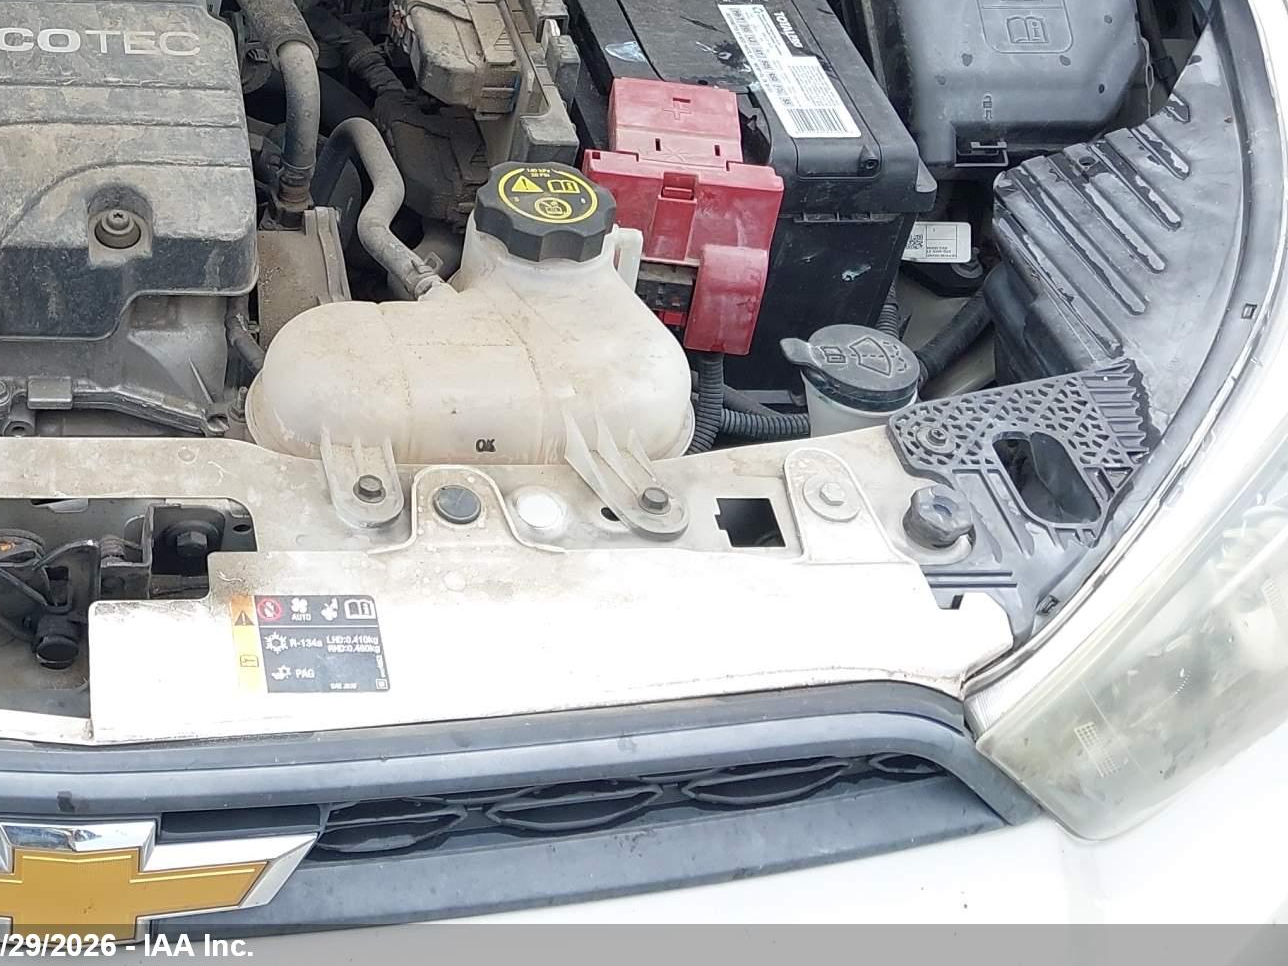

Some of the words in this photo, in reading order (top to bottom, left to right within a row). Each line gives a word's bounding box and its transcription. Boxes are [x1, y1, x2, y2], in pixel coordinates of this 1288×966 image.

[475, 439, 497, 452] OK
[292, 613, 311, 621] AUTO
[289, 638, 323, 648] R-134a
[295, 669, 315, 679] PAG
